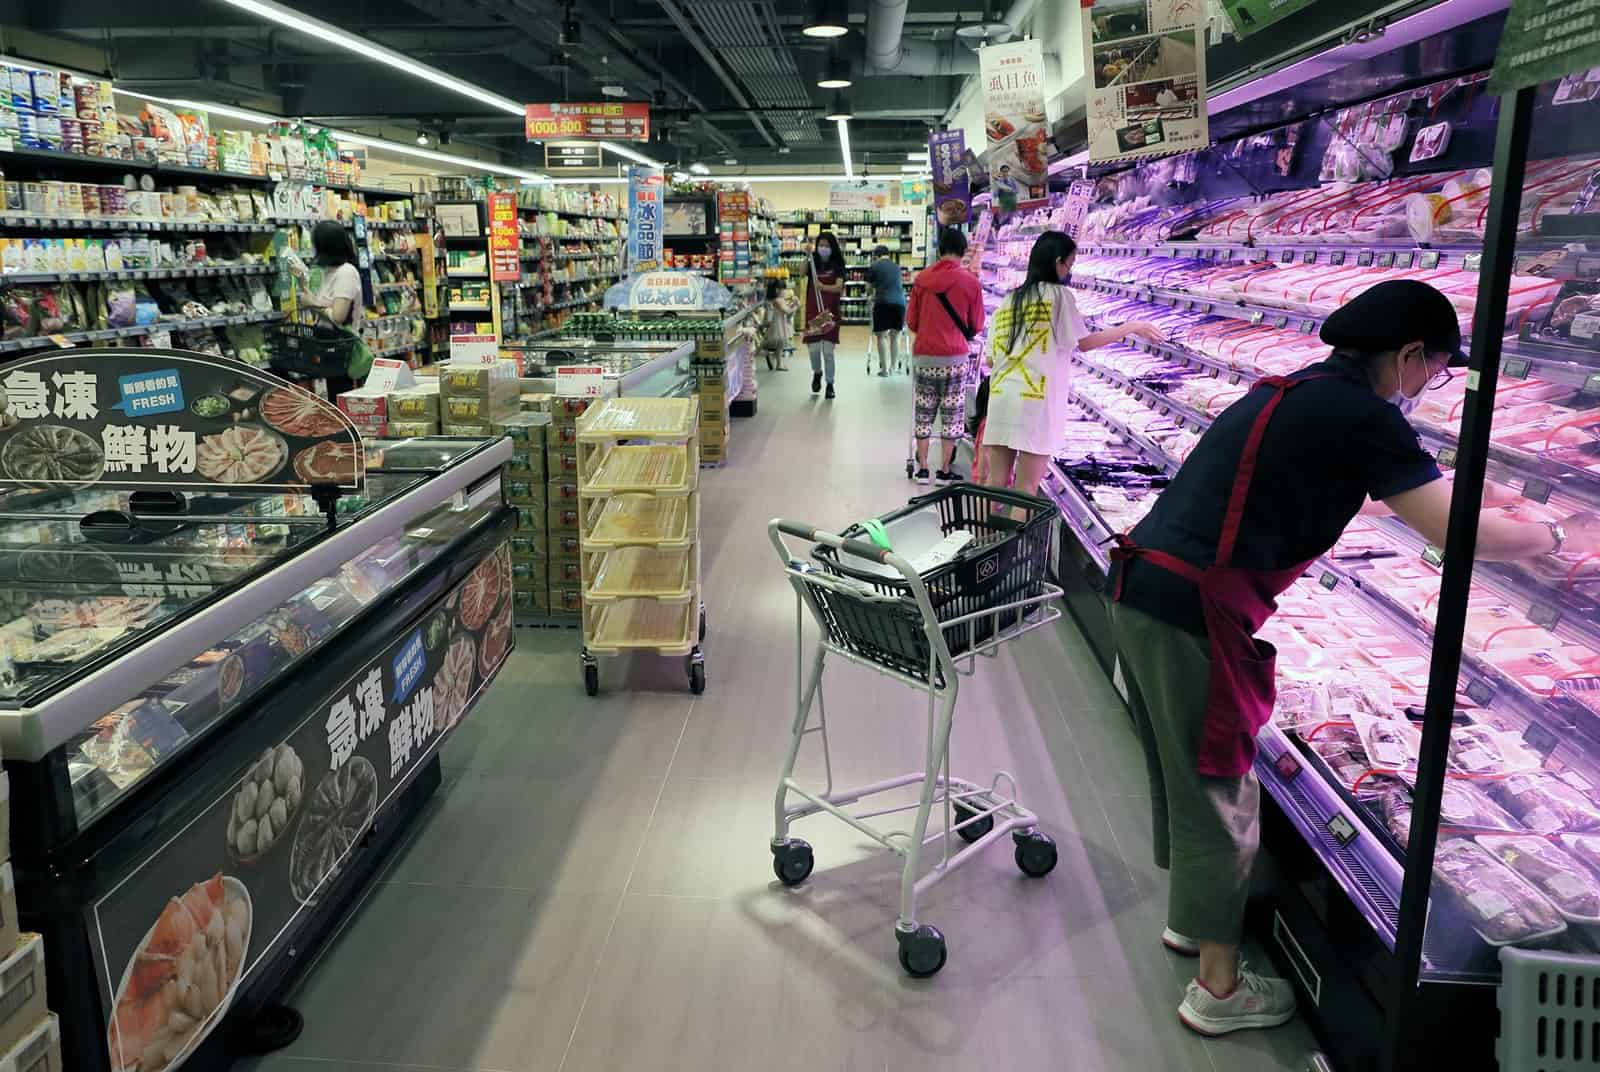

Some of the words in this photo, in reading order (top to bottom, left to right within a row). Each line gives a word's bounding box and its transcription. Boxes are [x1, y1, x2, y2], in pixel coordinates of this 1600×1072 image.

[2, 370, 99, 420] 急凍
[132, 392, 176, 410] FRESH
[101, 424, 198, 474] 鮮物
[325, 666, 386, 771] 急凍
[388, 686, 434, 779] 鮮物
